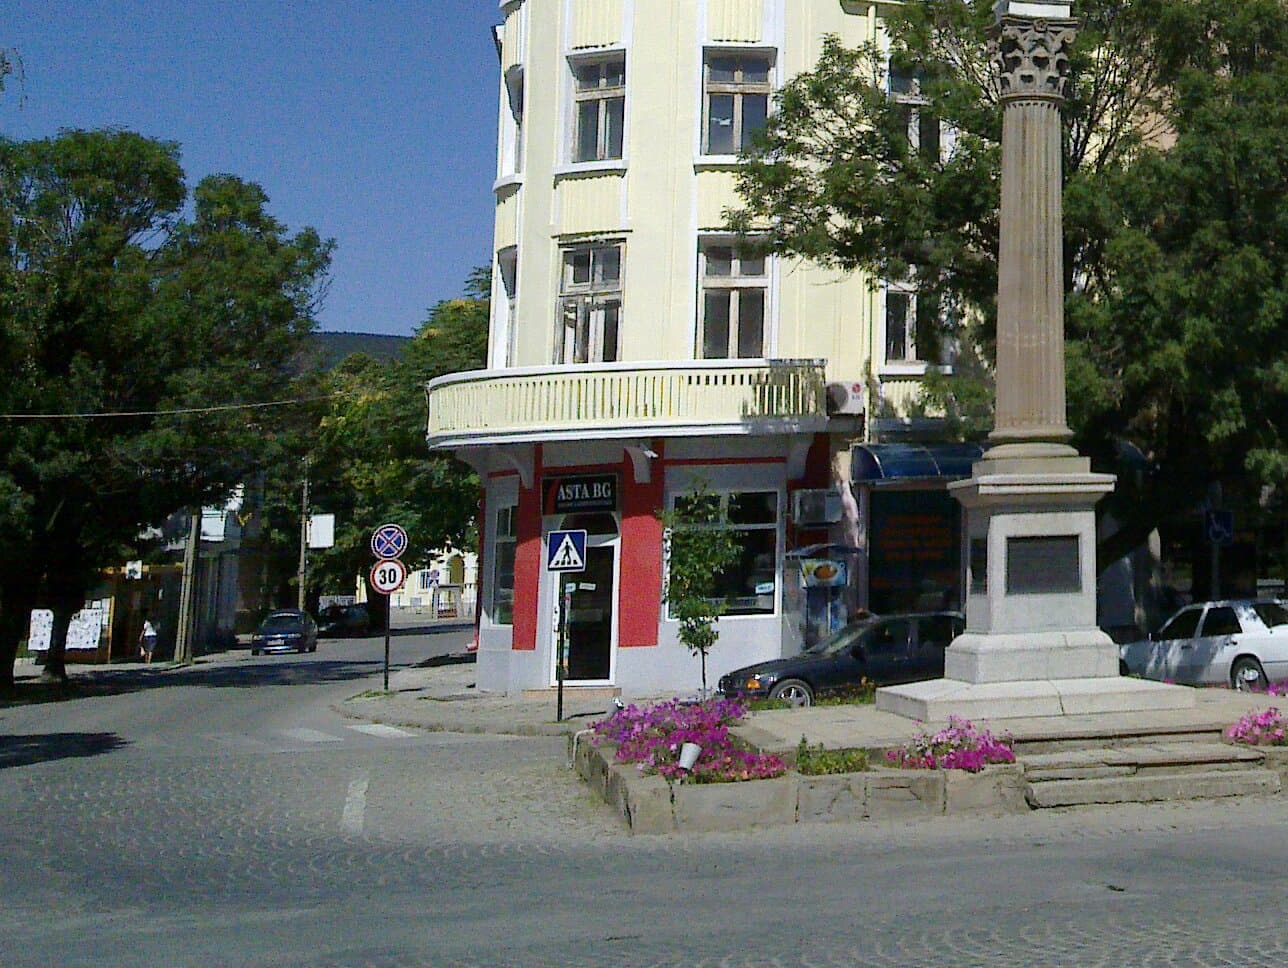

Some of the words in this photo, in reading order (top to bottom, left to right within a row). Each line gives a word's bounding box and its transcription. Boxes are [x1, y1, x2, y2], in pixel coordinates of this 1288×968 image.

[557, 483, 590, 501] ASTA
[592, 481, 612, 498] BG
[379, 568, 397, 585] 30
